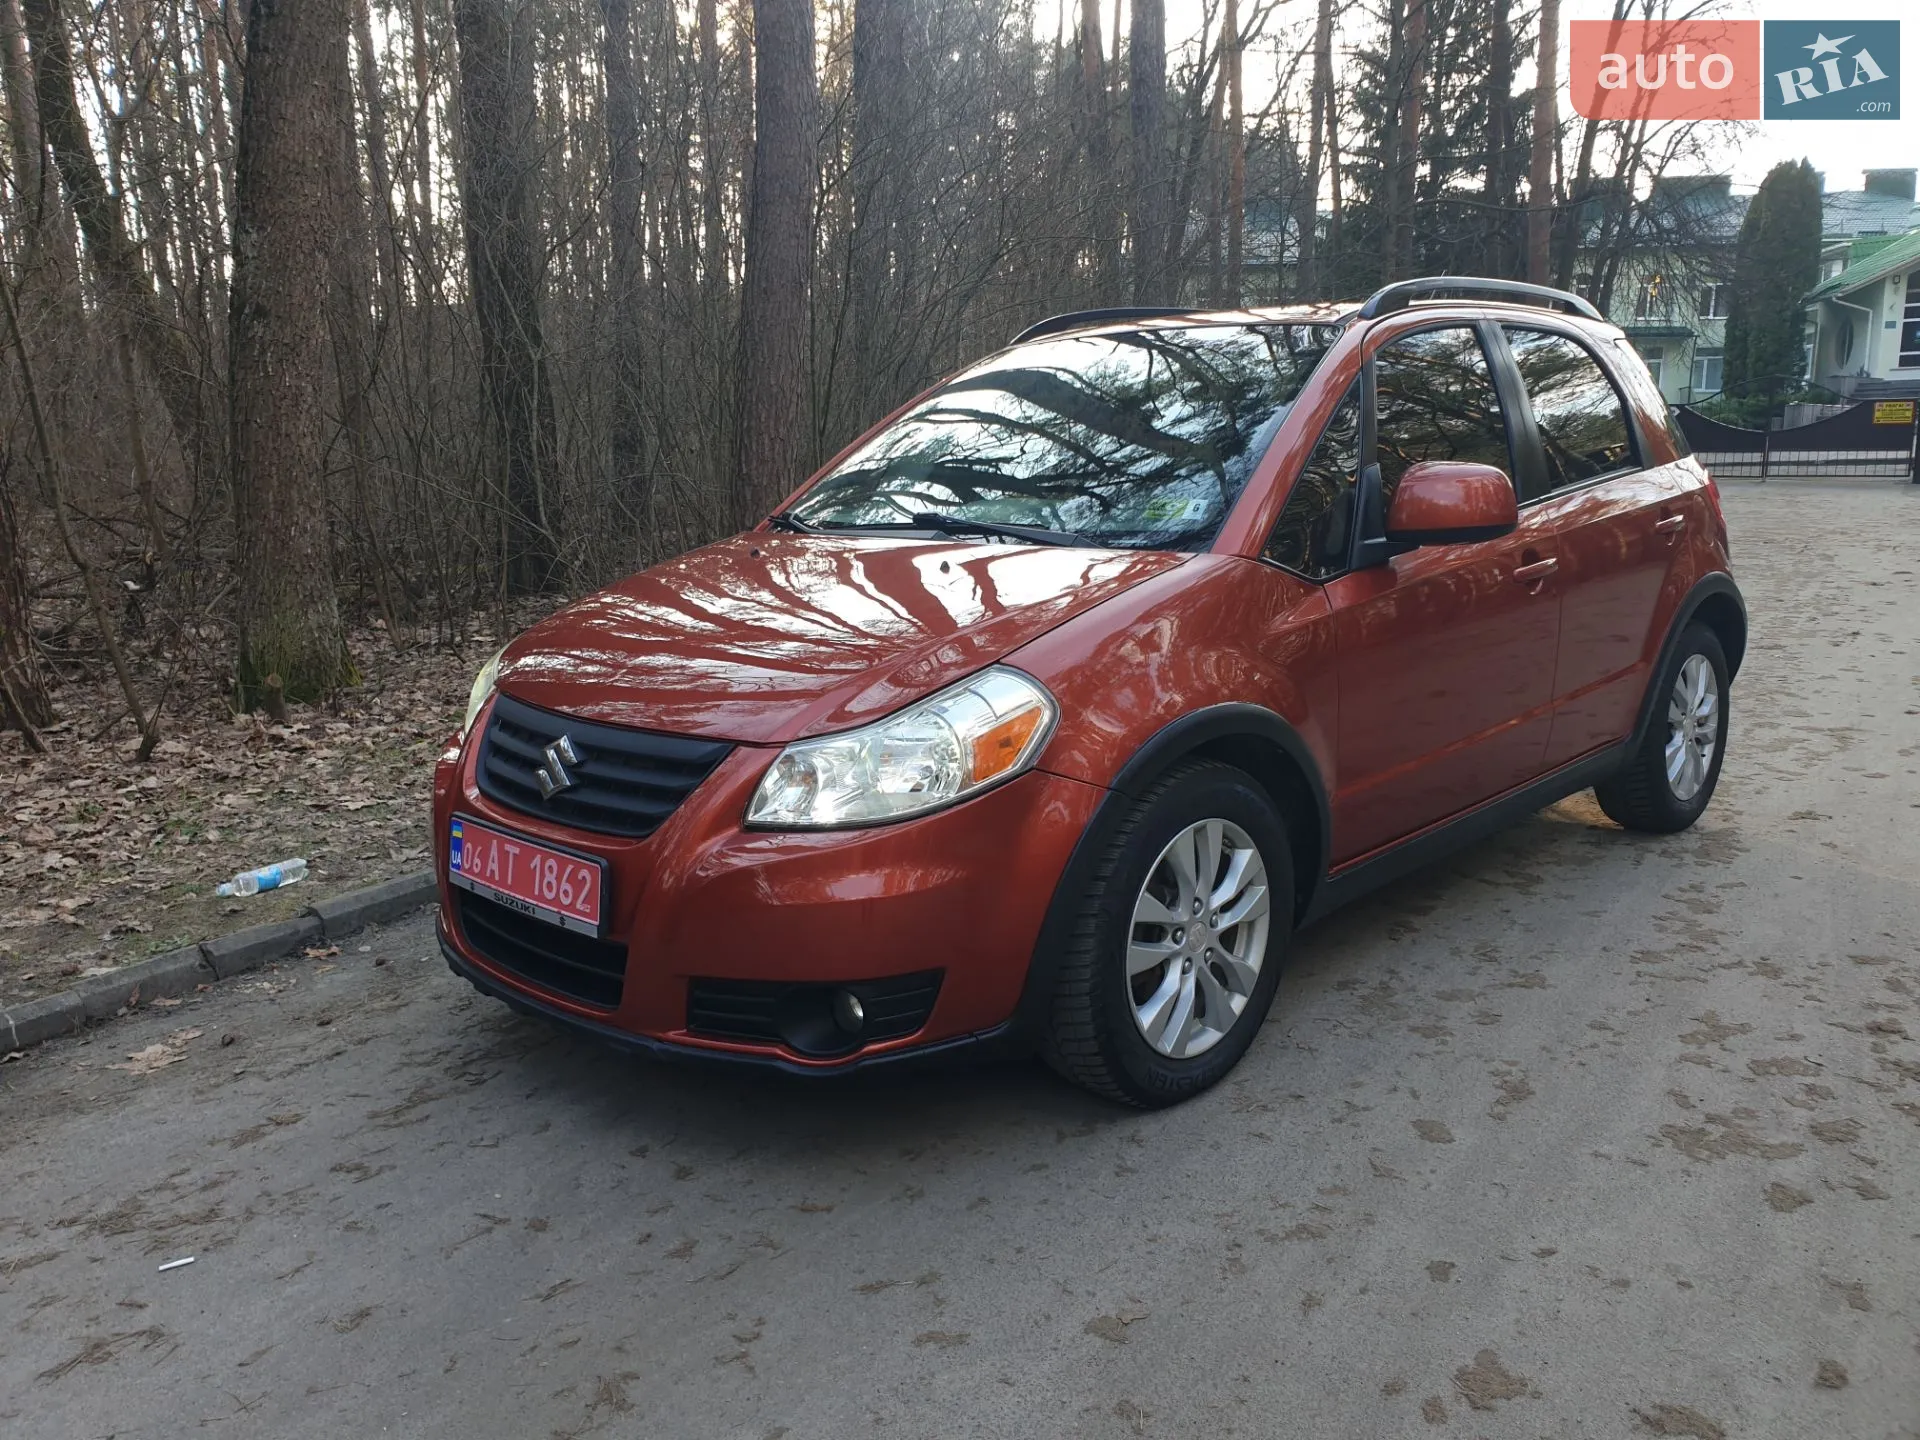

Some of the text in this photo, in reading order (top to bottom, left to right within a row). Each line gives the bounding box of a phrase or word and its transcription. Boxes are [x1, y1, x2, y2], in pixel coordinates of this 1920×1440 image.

[452, 850, 462, 865] UA
[463, 840, 591, 912] 06 AT 1862
[494, 892, 536, 914] SUZUKI
